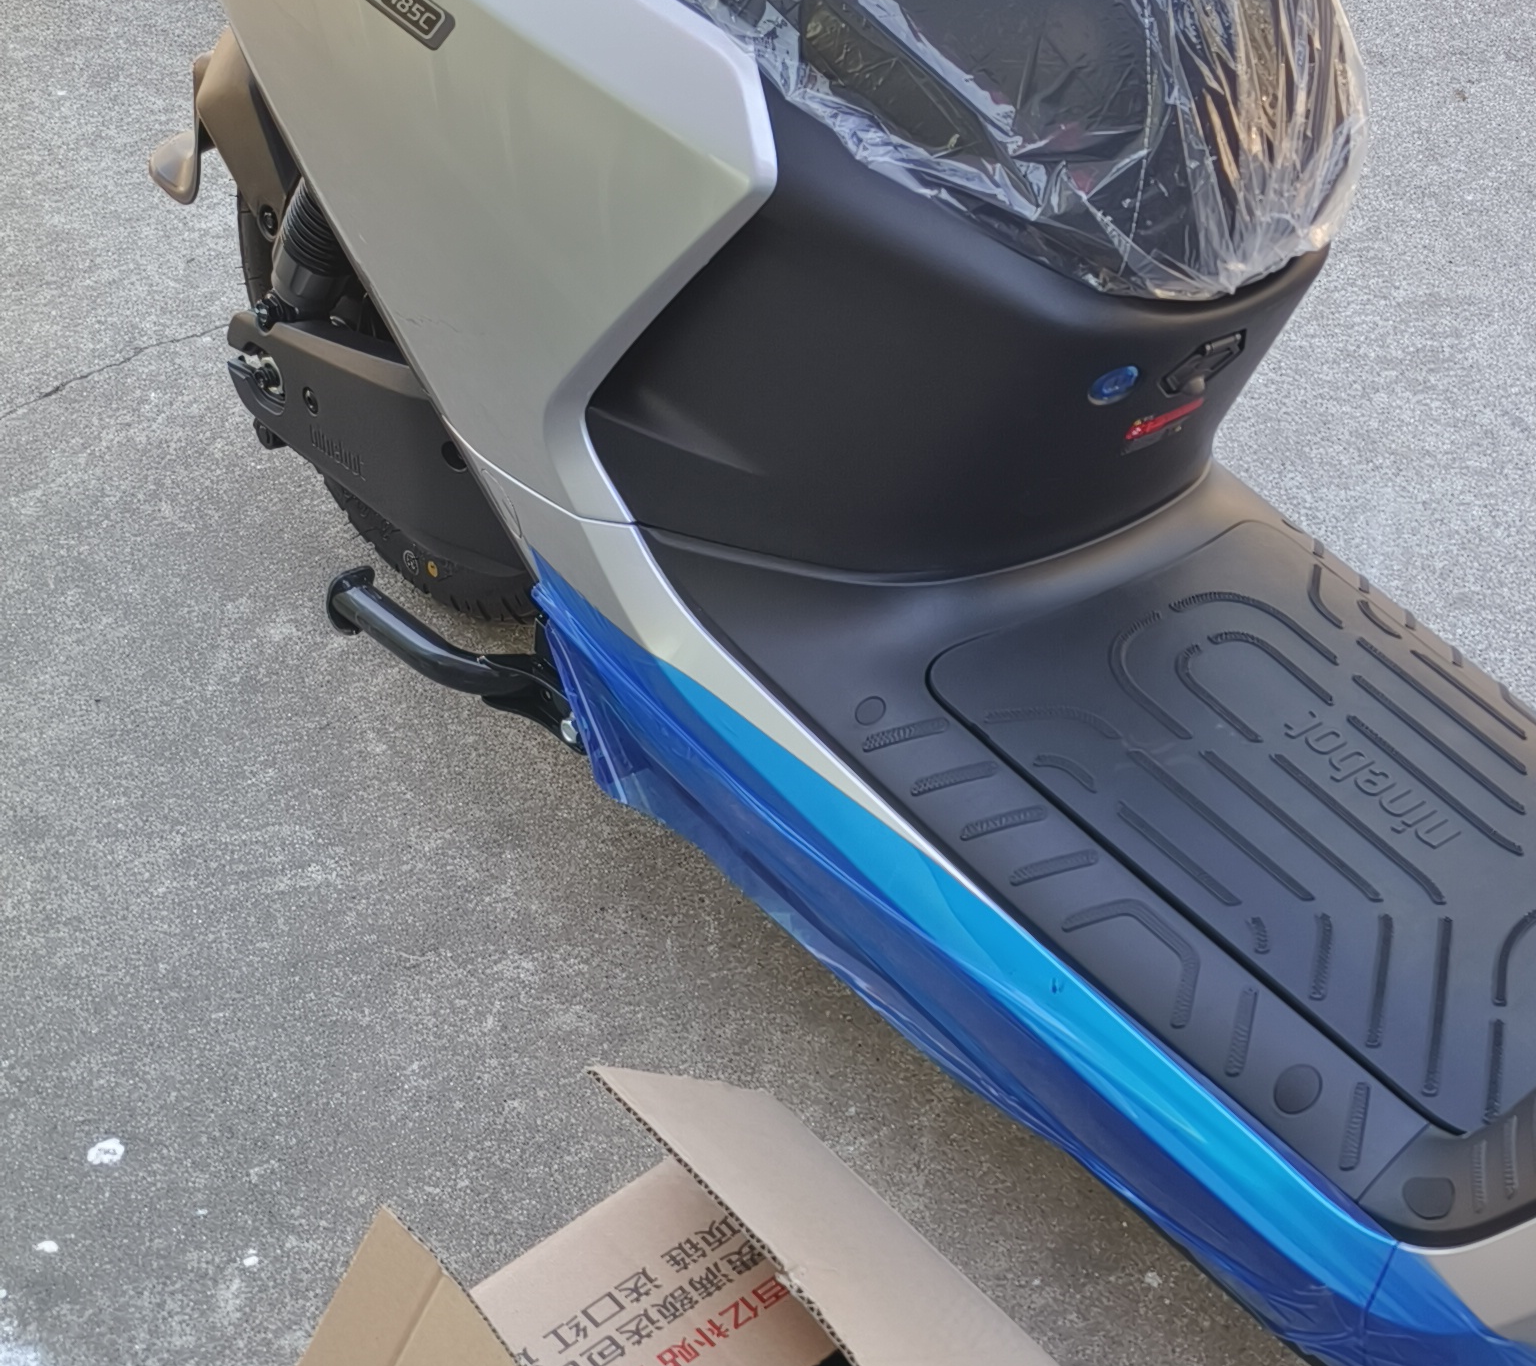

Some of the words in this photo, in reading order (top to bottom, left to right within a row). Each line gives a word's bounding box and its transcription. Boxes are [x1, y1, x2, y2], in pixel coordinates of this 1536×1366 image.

[1284, 710, 1462, 850] ninebot
[542, 1266, 664, 1355] 送口红
